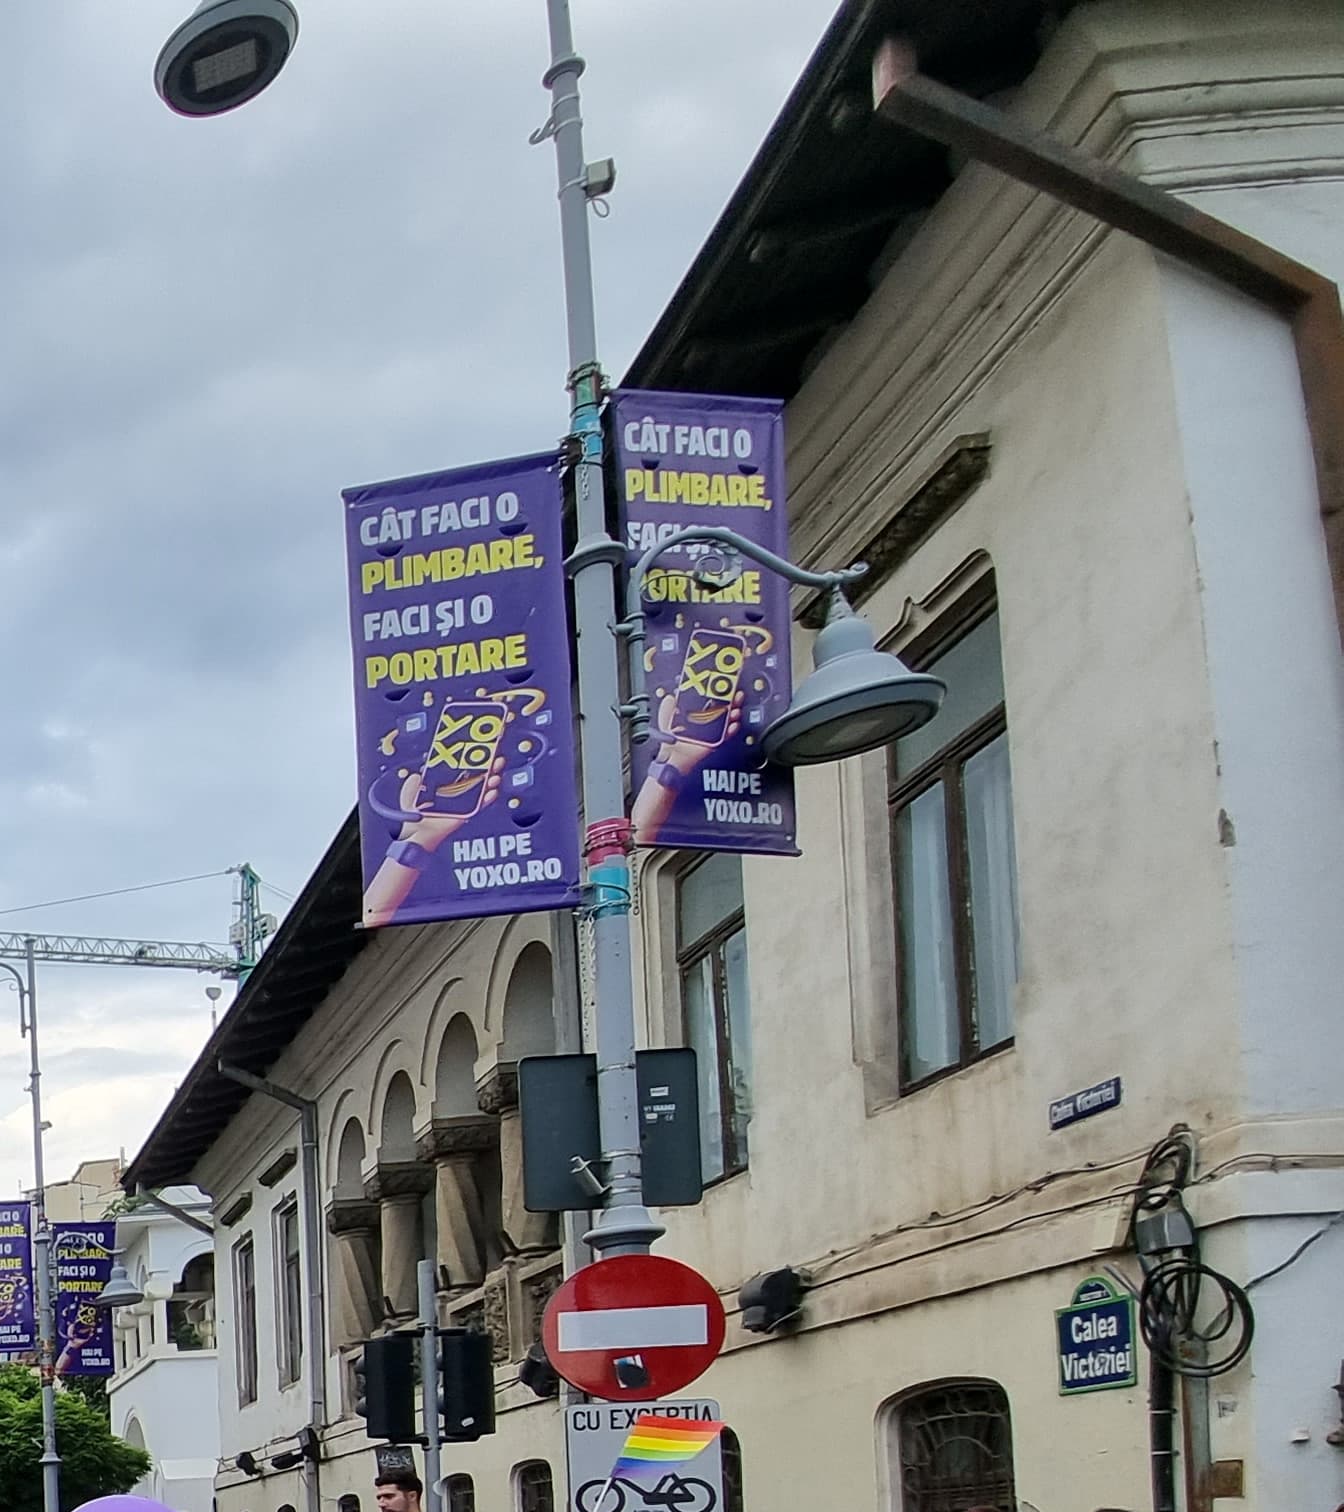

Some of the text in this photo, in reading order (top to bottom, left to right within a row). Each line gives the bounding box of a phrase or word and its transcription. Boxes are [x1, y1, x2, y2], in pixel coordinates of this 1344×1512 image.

[624, 416, 752, 459] CÂT FACI O
[625, 469, 773, 512] PLIMBARE,
[360, 491, 519, 547] CÂT FACI O
[361, 534, 545, 595] PLIMBARE,
[363, 594, 494, 642] FACI ȘI O
[365, 633, 528, 690] PORTARE
[702, 769, 762, 796] HAI PE
[703, 797, 784, 826] YOXO.RO
[452, 832, 533, 864] HAI PE
[454, 856, 563, 890] YOXO.RO
[1072, 1312, 1118, 1344] Calea
[1062, 1343, 1132, 1381] Victoriei
[573, 1410, 600, 1431] CU
